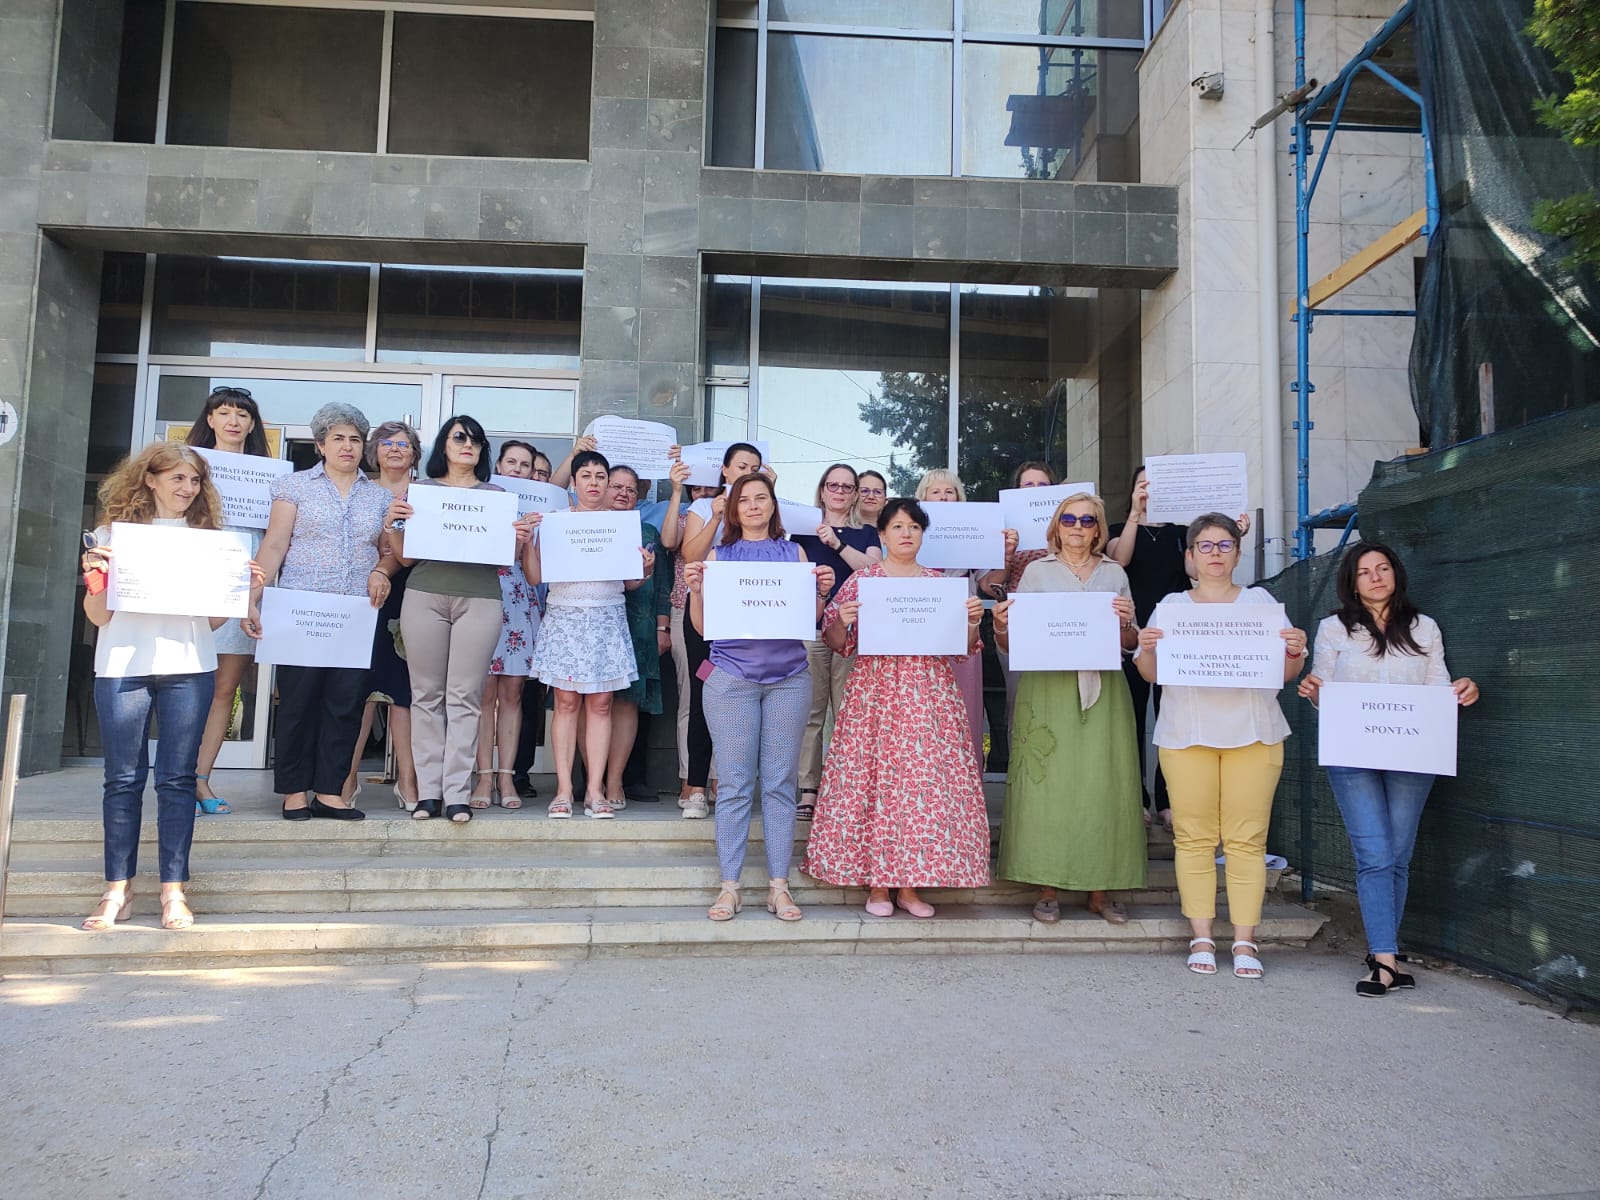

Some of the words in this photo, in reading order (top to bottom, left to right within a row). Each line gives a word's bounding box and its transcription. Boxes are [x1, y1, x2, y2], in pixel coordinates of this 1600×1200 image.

[442, 502, 485, 513] PROTEST
[443, 522, 487, 533] SPONTAN
[739, 578, 782, 587] PROTEST
[742, 599, 787, 607] SPONTAN
[291, 609, 339, 619] FUNCTIONARII
[295, 619, 313, 627] SUNT
[315, 621, 343, 629] INAMICII
[306, 630, 331, 638] PUBLICI
[1362, 702, 1416, 712] PROTEST
[1364, 725, 1420, 736] SPONTAN
